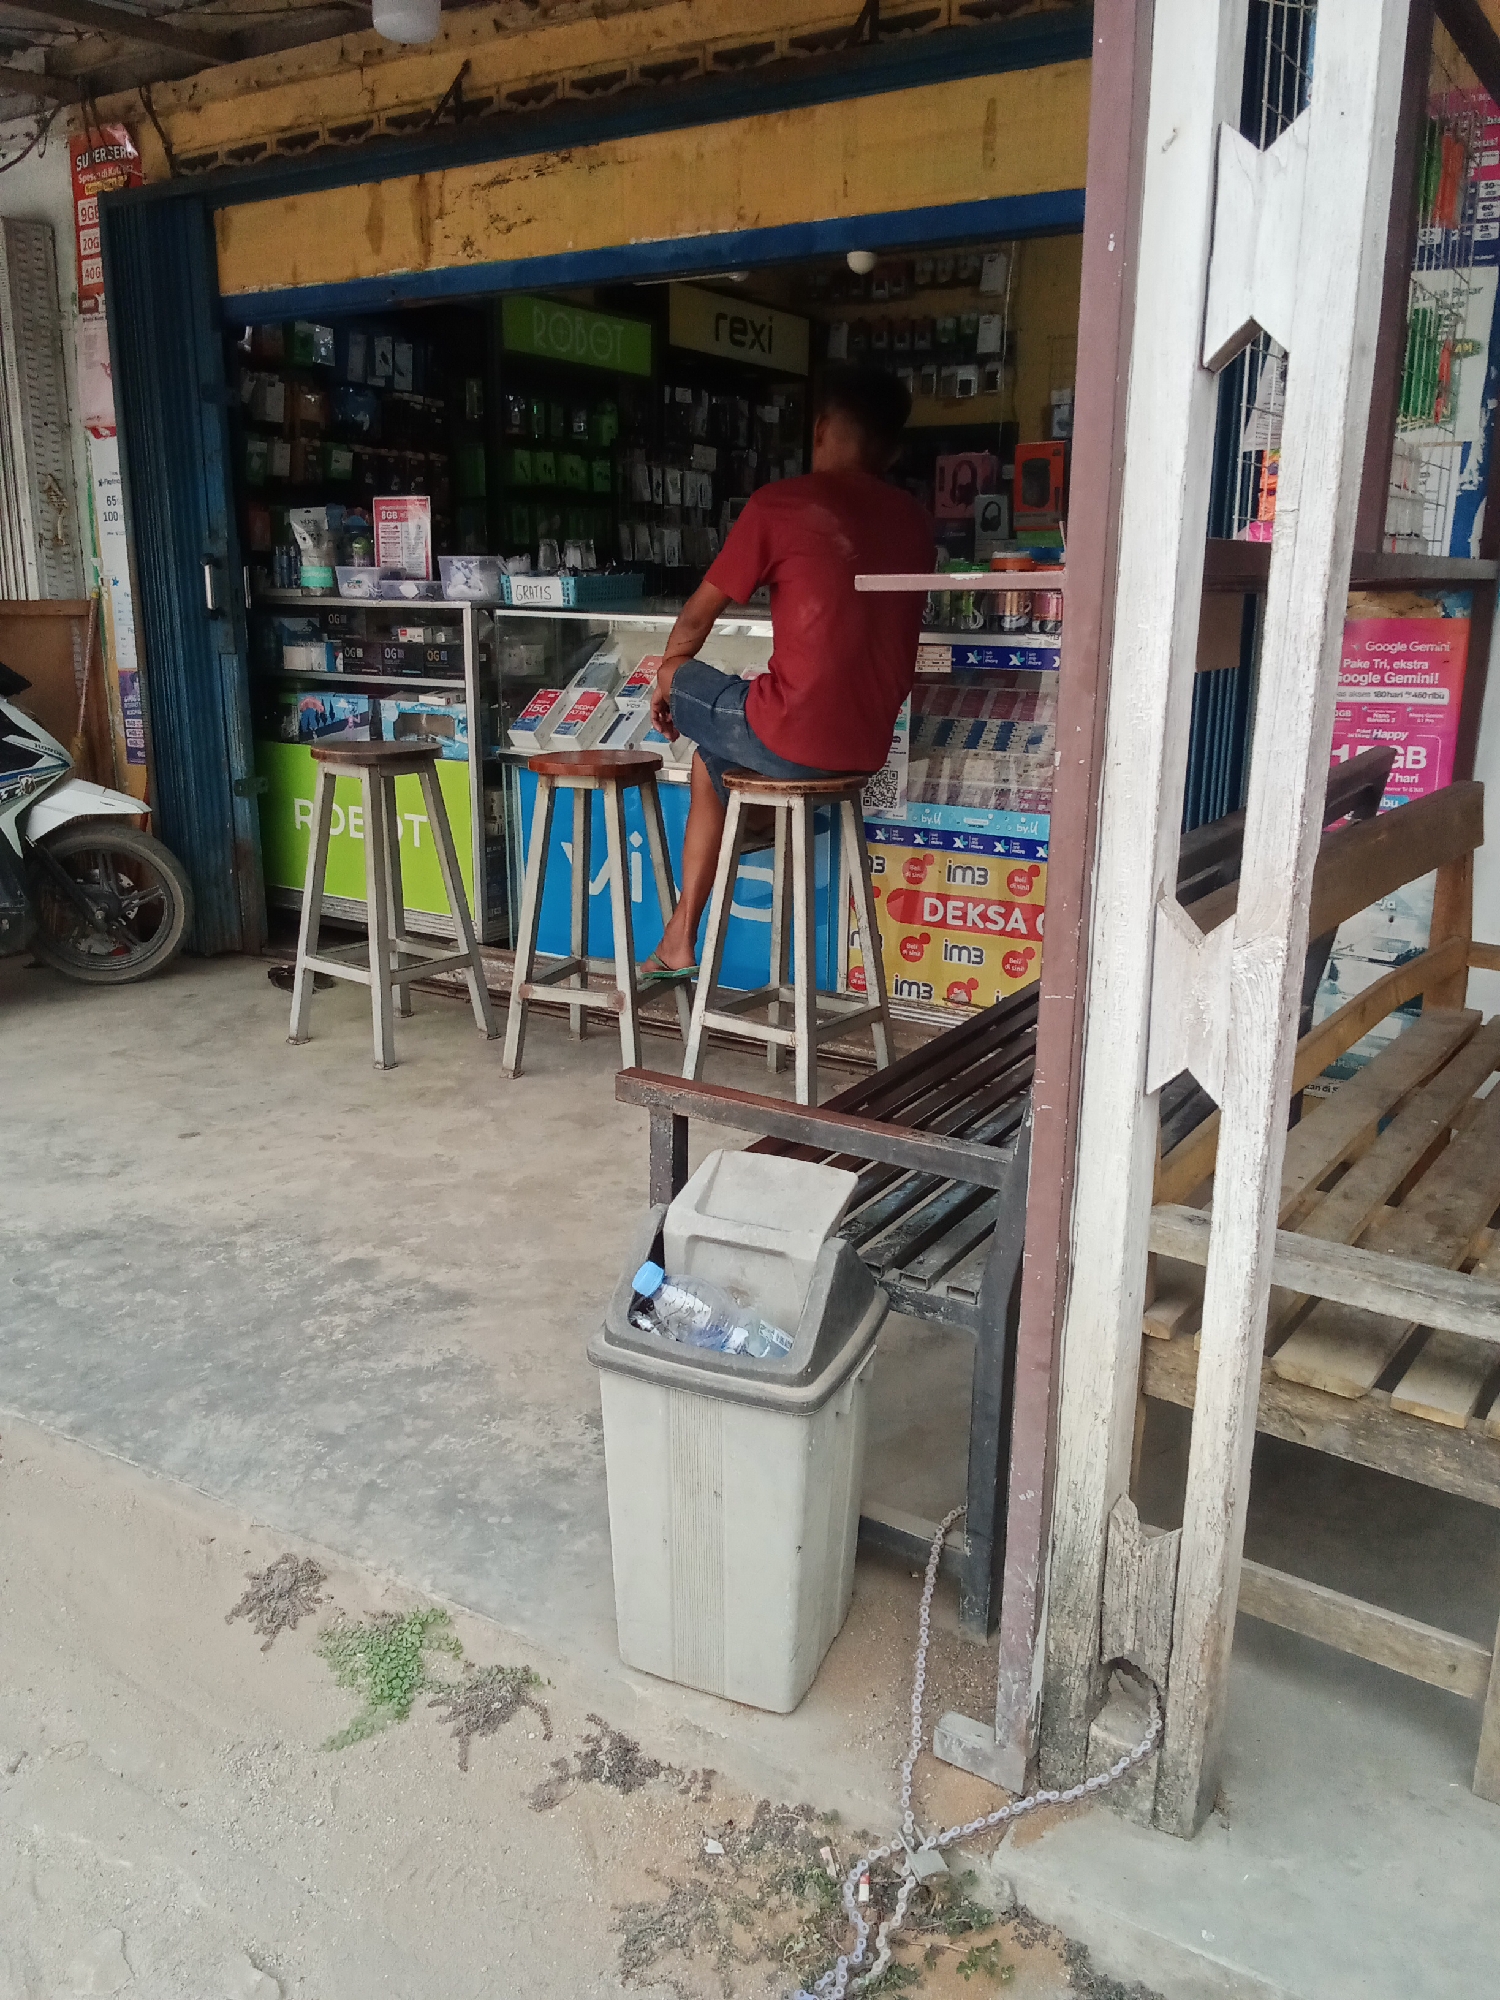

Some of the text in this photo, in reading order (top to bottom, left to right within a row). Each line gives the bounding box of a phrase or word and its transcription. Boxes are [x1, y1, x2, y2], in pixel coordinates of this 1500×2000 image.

[82, 237, 100, 251] 20G
[85, 266, 101, 280] 40G
[715, 311, 773, 355] rexi
[106, 495, 117, 507] 65
[103, 511, 118, 522] 100
[515, 584, 552, 602] GRATIS
[1365, 641, 1451, 654] Google Gemini
[1342, 658, 1429, 670] Pake Tri, ekstra
[1384, 672, 1439, 685] Gemini!
[1372, 728, 1409, 741] Happy
[1395, 772, 1420, 784] hari
[921, 811, 941, 826] by.U
[1016, 818, 1039, 835] by.U
[946, 859, 989, 886] im3
[923, 897, 1028, 935] DEKSA
[944, 938, 984, 966] im3
[893, 974, 934, 999] im3
